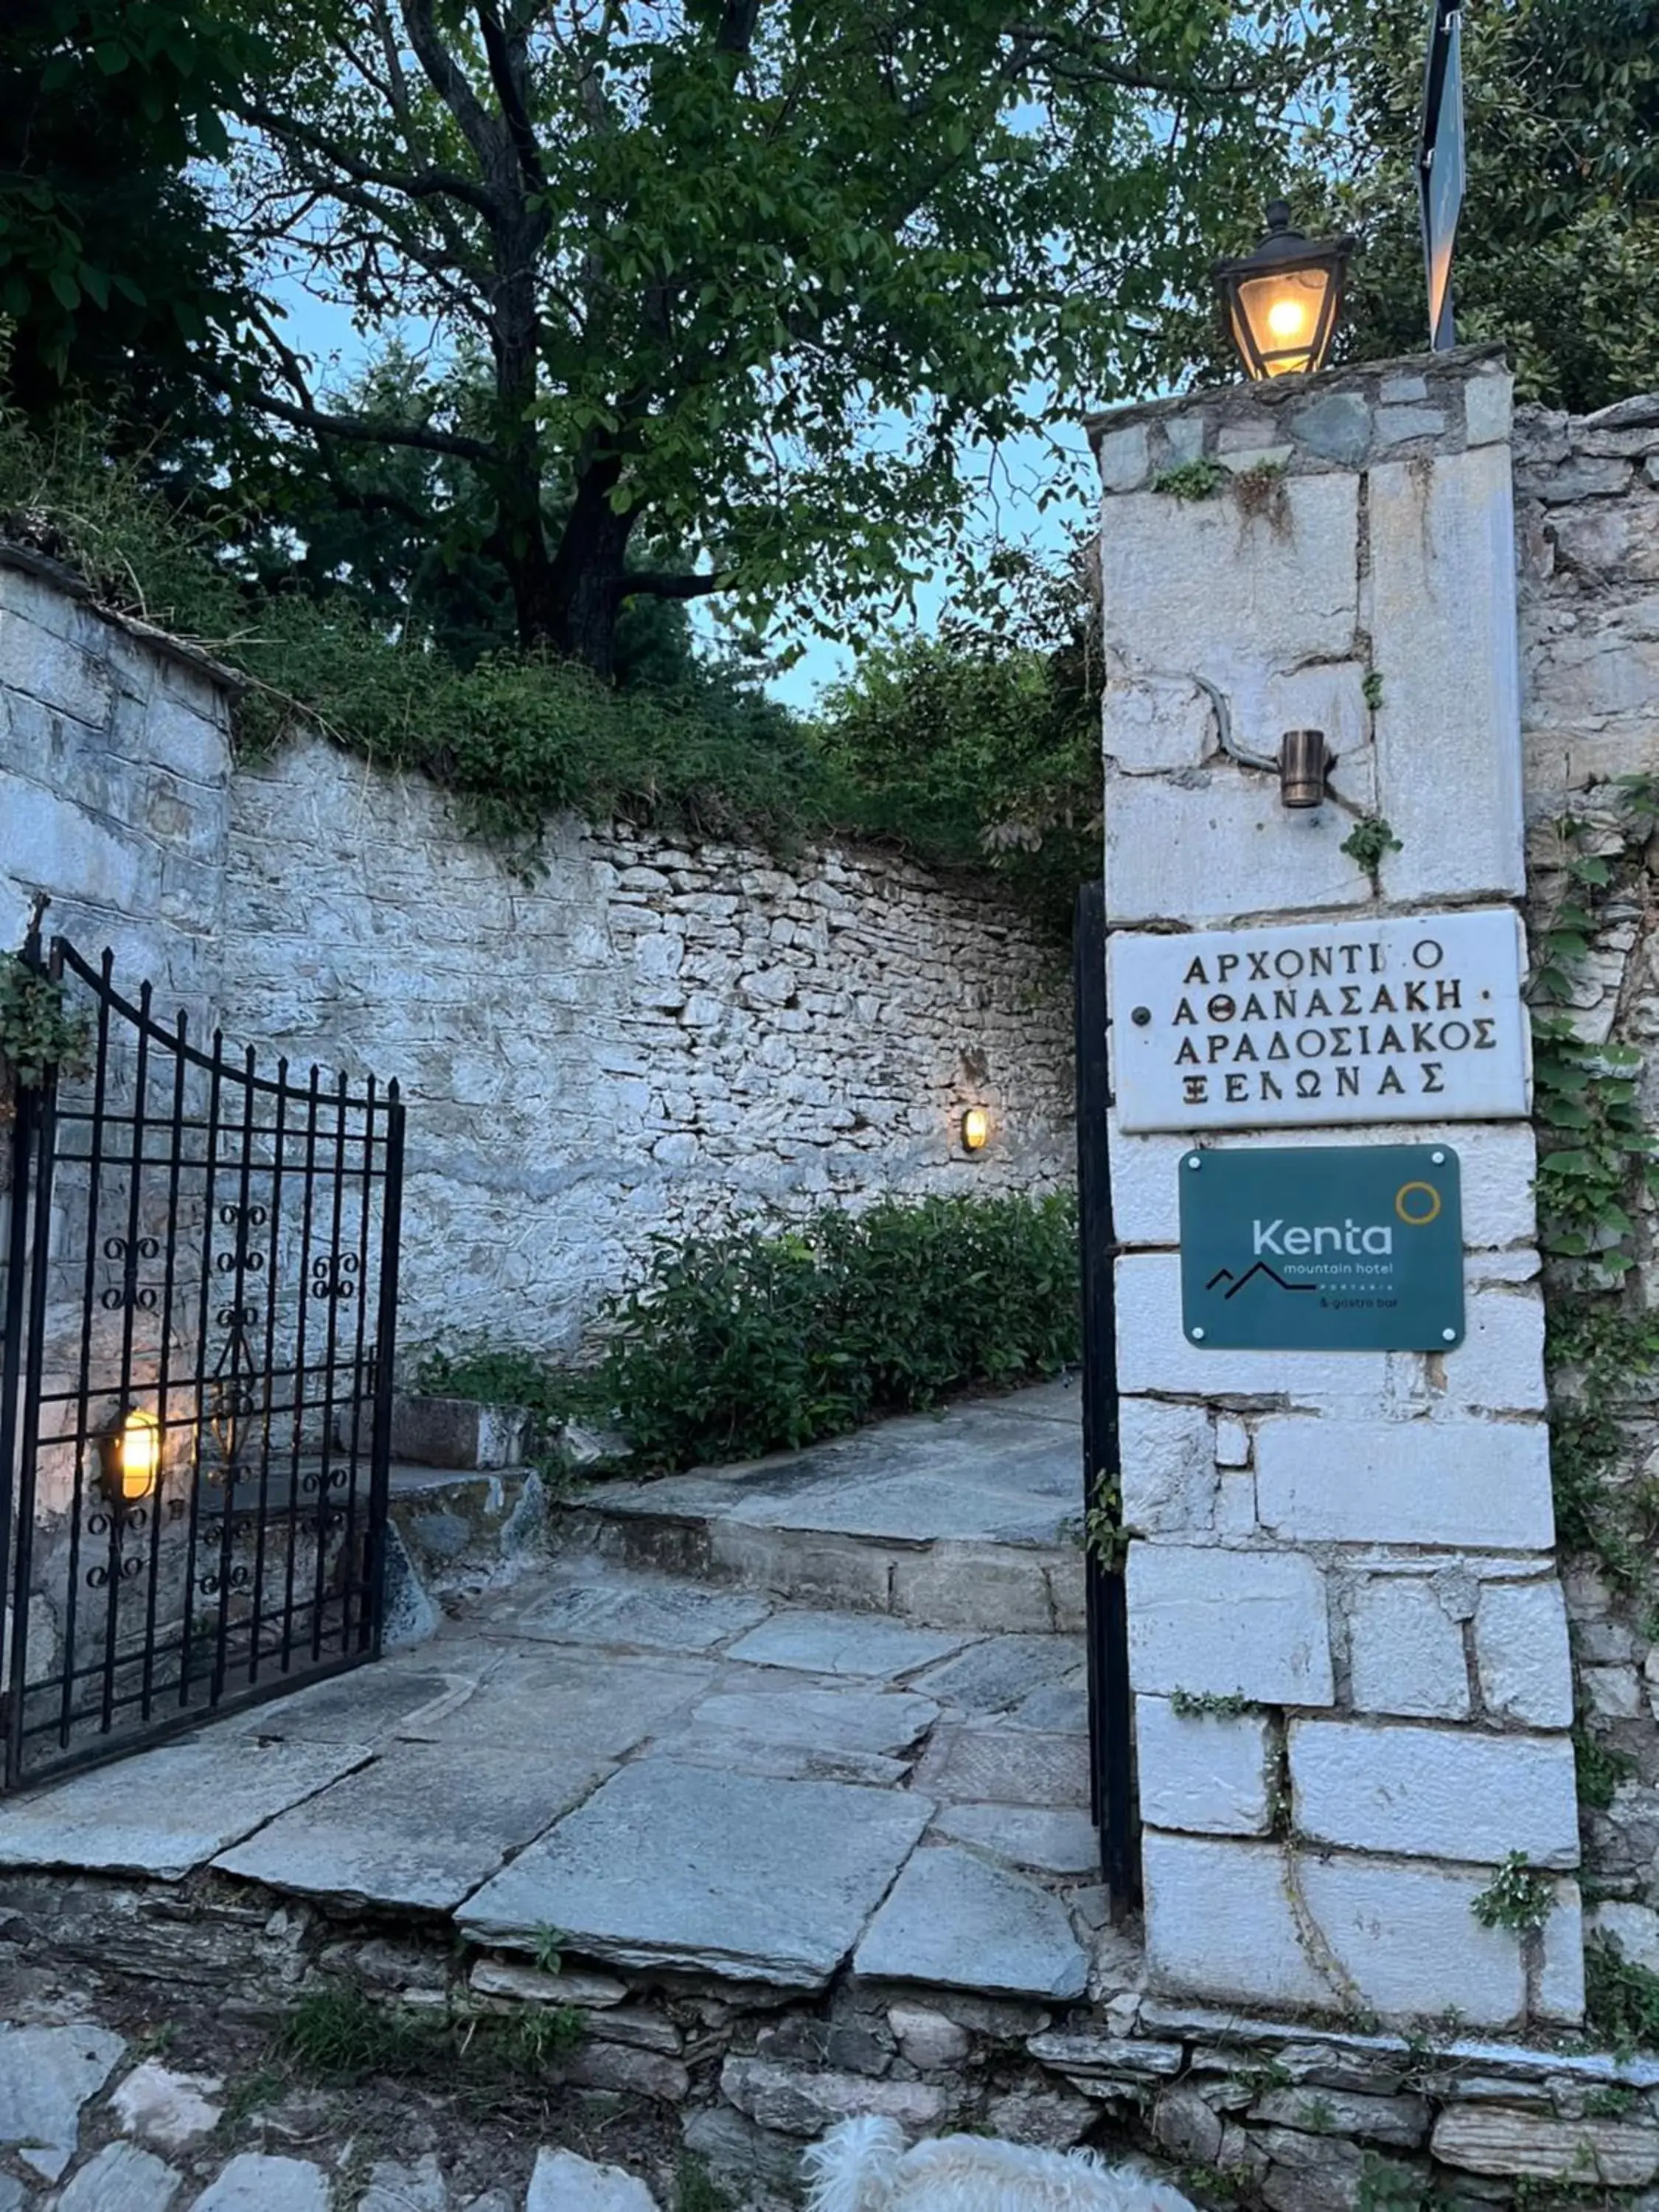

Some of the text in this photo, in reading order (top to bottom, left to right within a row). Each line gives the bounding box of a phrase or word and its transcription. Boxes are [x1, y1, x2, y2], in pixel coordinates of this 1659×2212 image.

[1172, 978, 1462, 1026] ΑΘΑΝΑΣΑΚΗ
[1175, 1018, 1497, 1065] ΑΡΑΔΟΣΙΑΚΟΣ
[1182, 1062, 1444, 1104] ΞΕΝΩΝΑΣ
[1253, 1218, 1393, 1255] Kenta
[1284, 1262, 1393, 1274] mountain hotel
[1377, 1297, 1398, 1308] bar
